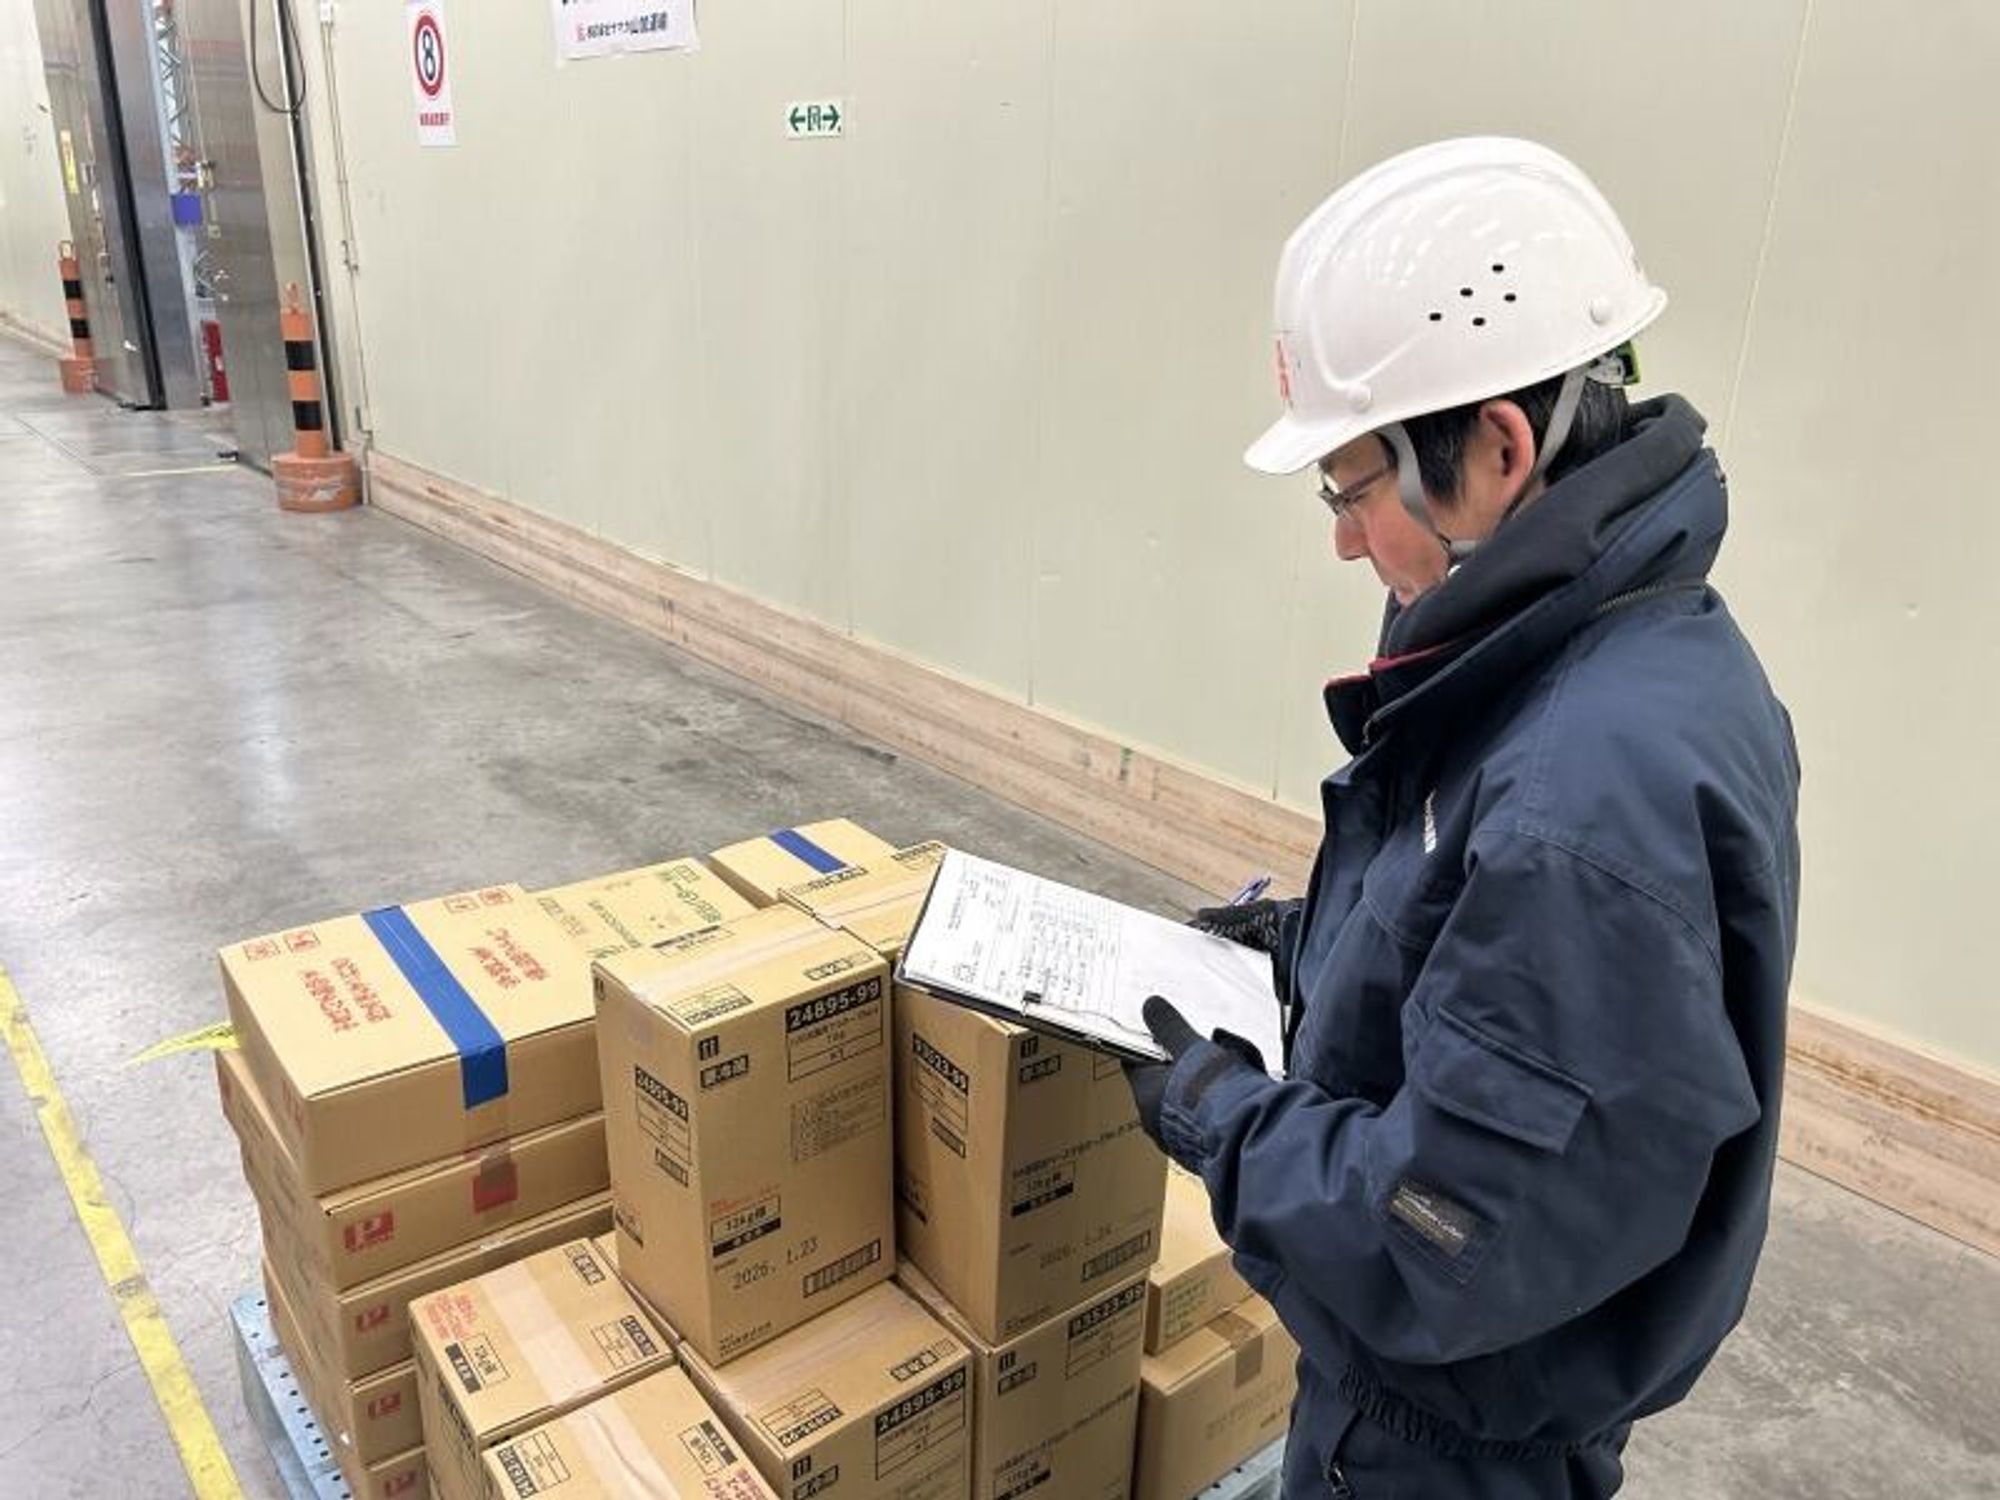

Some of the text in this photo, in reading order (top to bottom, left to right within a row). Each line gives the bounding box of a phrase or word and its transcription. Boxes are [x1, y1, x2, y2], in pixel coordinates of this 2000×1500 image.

[422, 28, 436, 81] 8
[789, 978, 880, 1029] 24895-99
[878, 1370, 965, 1433] 24895-99
